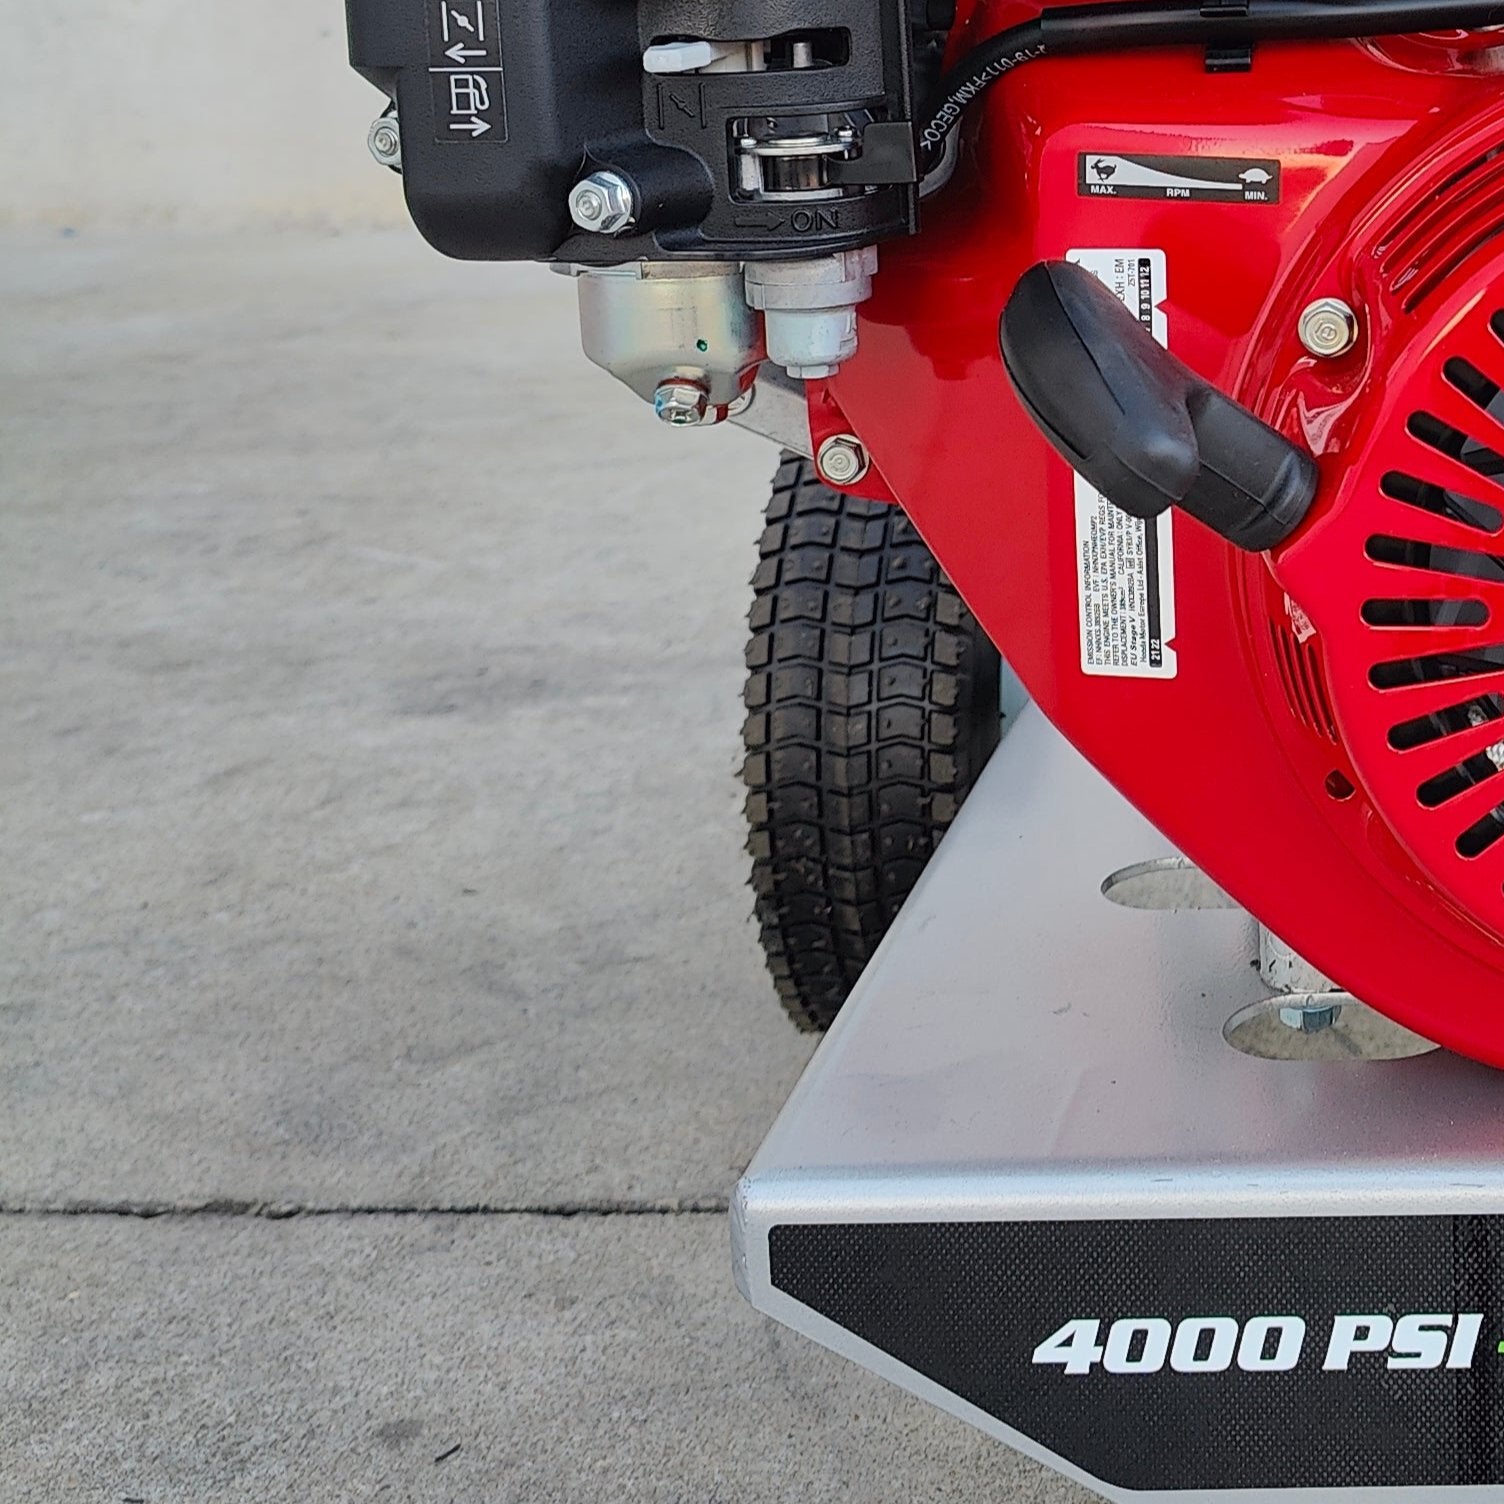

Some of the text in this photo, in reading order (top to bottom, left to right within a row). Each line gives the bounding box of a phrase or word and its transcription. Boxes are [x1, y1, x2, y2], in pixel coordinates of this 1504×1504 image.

[1090, 184, 1268, 201] MAX. RPM MIN.
[790, 207, 839, 232] ON
[1114, 258, 1124, 274] EM
[1140, 266, 1150, 277] 12
[1140, 278, 1150, 288] 11
[1140, 289, 1150, 300] 10
[1117, 535, 1125, 575] CALIFORNIA
[1082, 540, 1094, 664] EMISSION CONTROL INFORMATION
[1101, 593, 1109, 617] MEETS
[1110, 582, 1118, 615] OWNER'S
[1138, 593, 1146, 617] Europe
[1120, 615, 1128, 666] DISPLACEMENT
[1130, 624, 1138, 651] Stage
[1138, 619, 1146, 639] Motor
[1103, 649, 1111, 665] THIS
[1130, 653, 1137, 666] EU
[1150, 638, 1160, 661] 21 22
[1031, 1314, 1306, 1376] 4000
[1321, 1312, 1485, 1374] PSI
